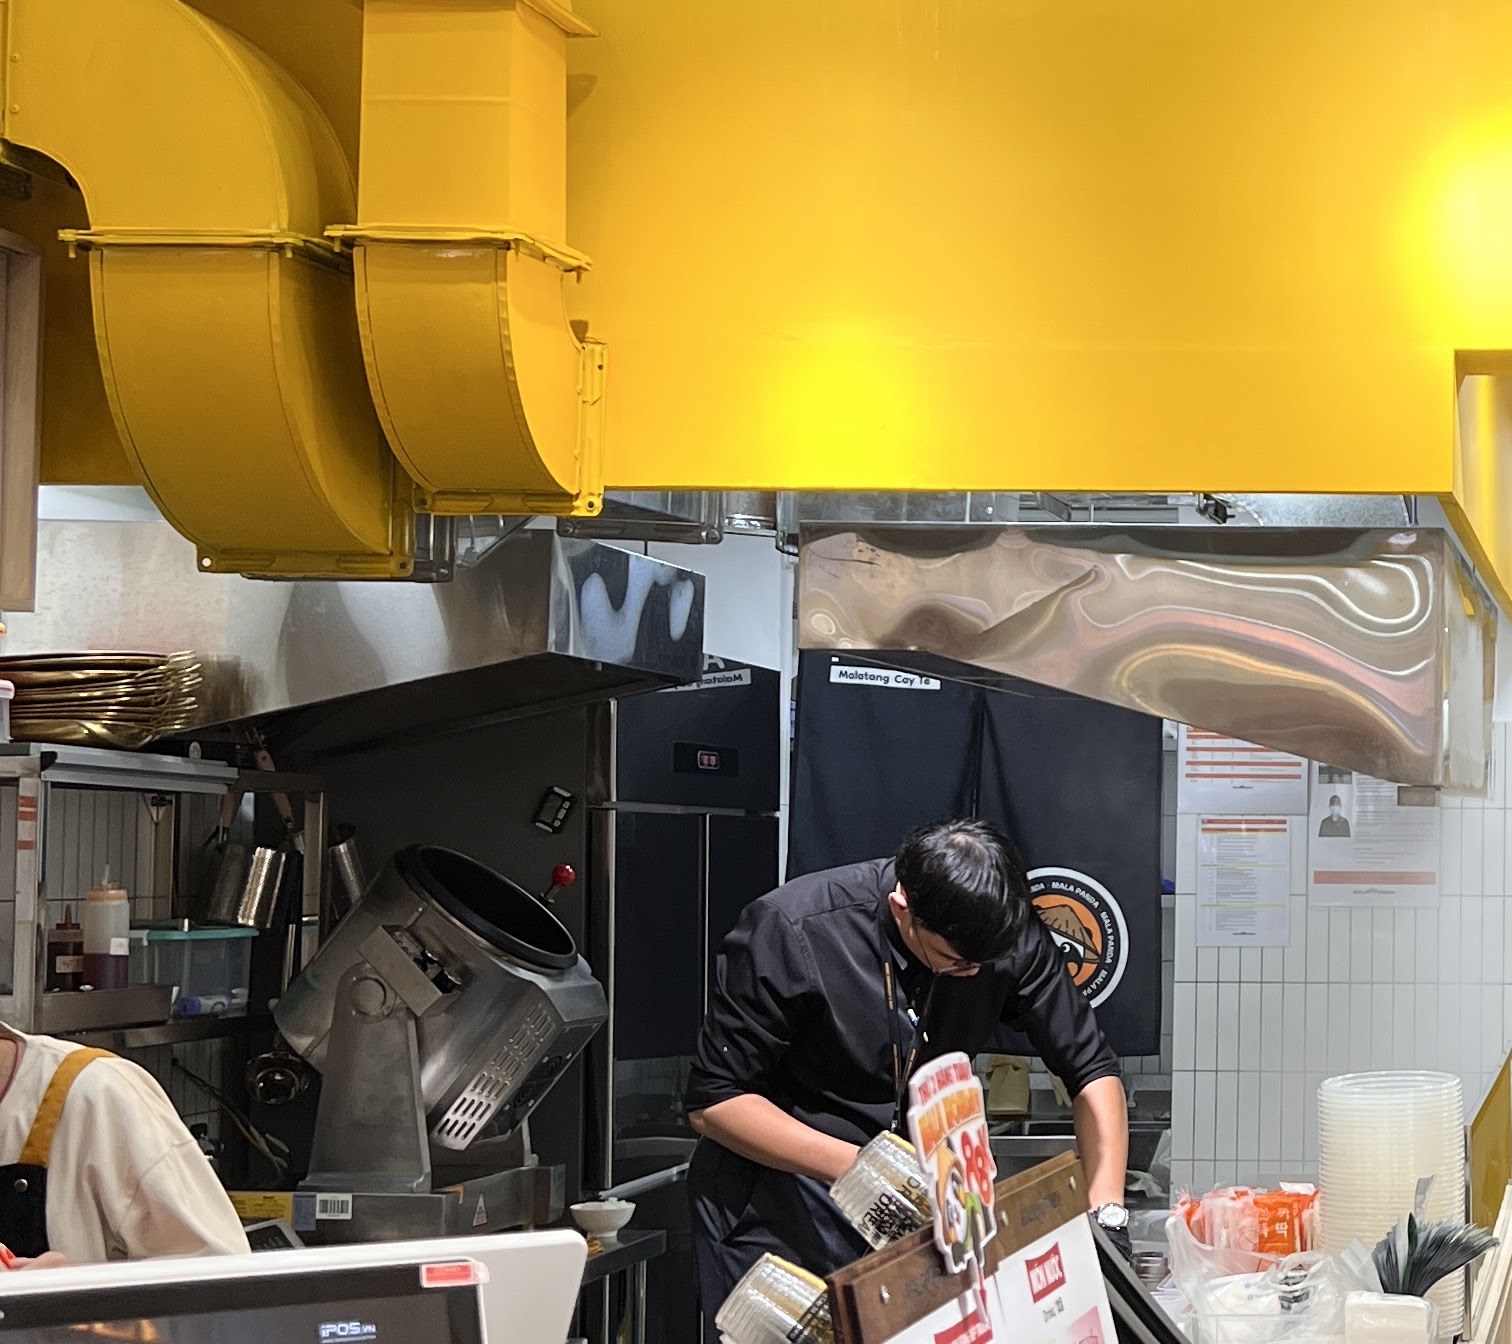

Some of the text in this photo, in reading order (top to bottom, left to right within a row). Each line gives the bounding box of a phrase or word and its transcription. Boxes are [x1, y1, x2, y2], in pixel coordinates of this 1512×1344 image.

[838, 669, 890, 685] Malatang
[894, 674, 915, 687] Cay
[1051, 881, 1074, 893] MALA
[1075, 887, 1100, 909] PANDA
